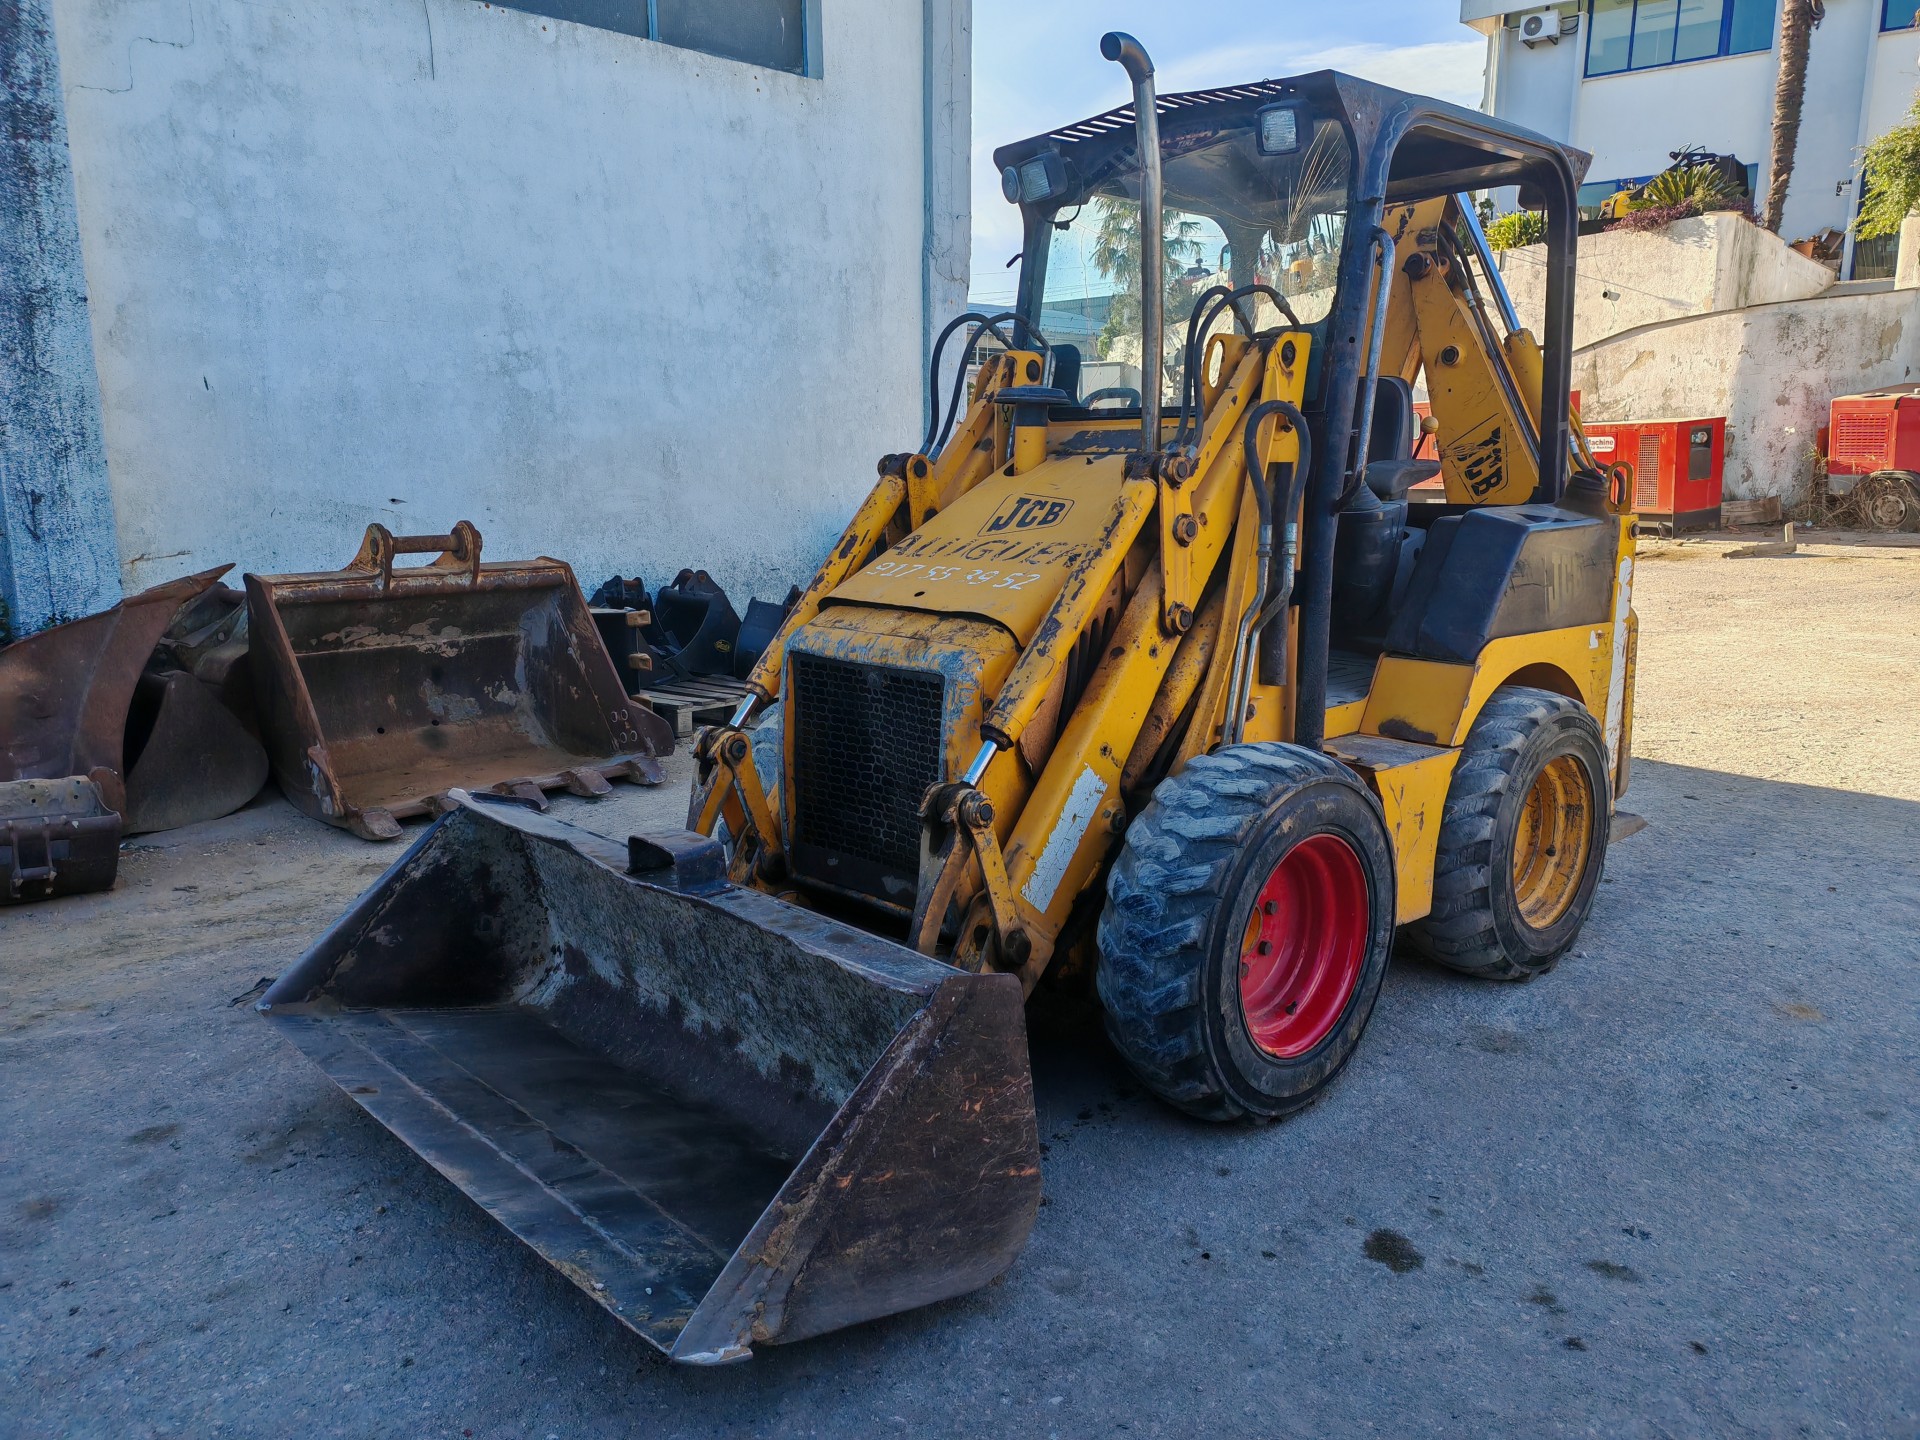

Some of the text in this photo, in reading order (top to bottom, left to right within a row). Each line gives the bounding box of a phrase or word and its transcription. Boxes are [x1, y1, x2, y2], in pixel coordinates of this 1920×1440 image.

[1453, 426, 1502, 496] JCB
[986, 497, 1067, 534] JCB
[866, 561, 926, 579] 917
[917, 565, 962, 581] 55
[992, 572, 1041, 590] 52
